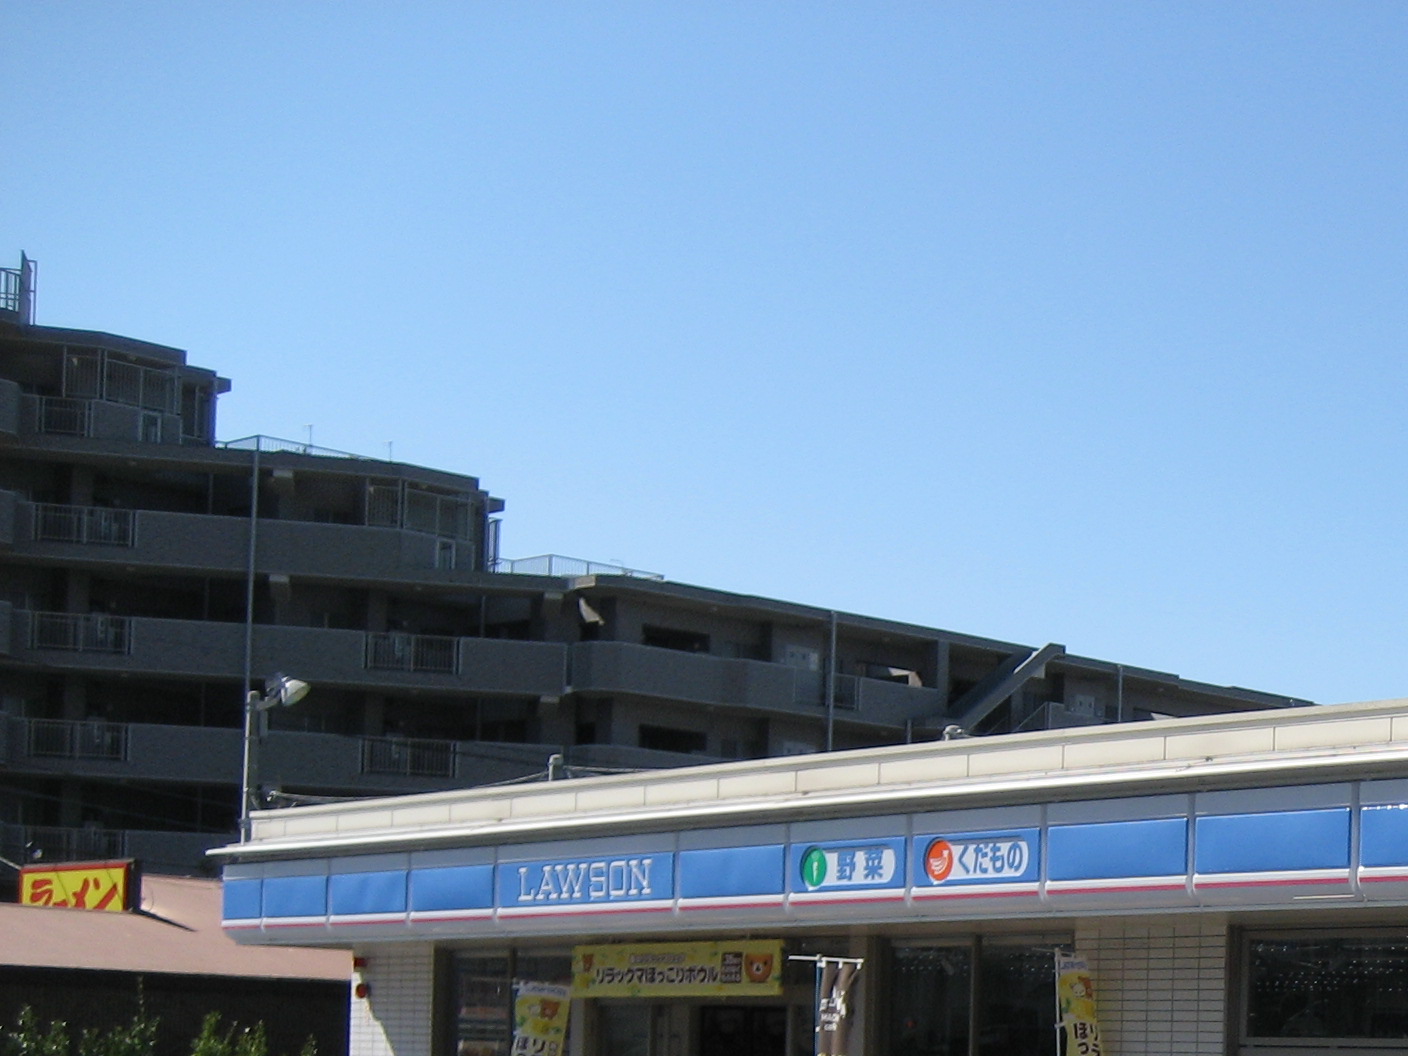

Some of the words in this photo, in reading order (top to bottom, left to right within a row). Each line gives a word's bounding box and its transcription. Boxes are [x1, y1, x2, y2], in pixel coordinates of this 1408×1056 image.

[836, 850, 884, 881] 野菜
[957, 841, 1023, 875] くだもの
[518, 858, 653, 903] LAWSON
